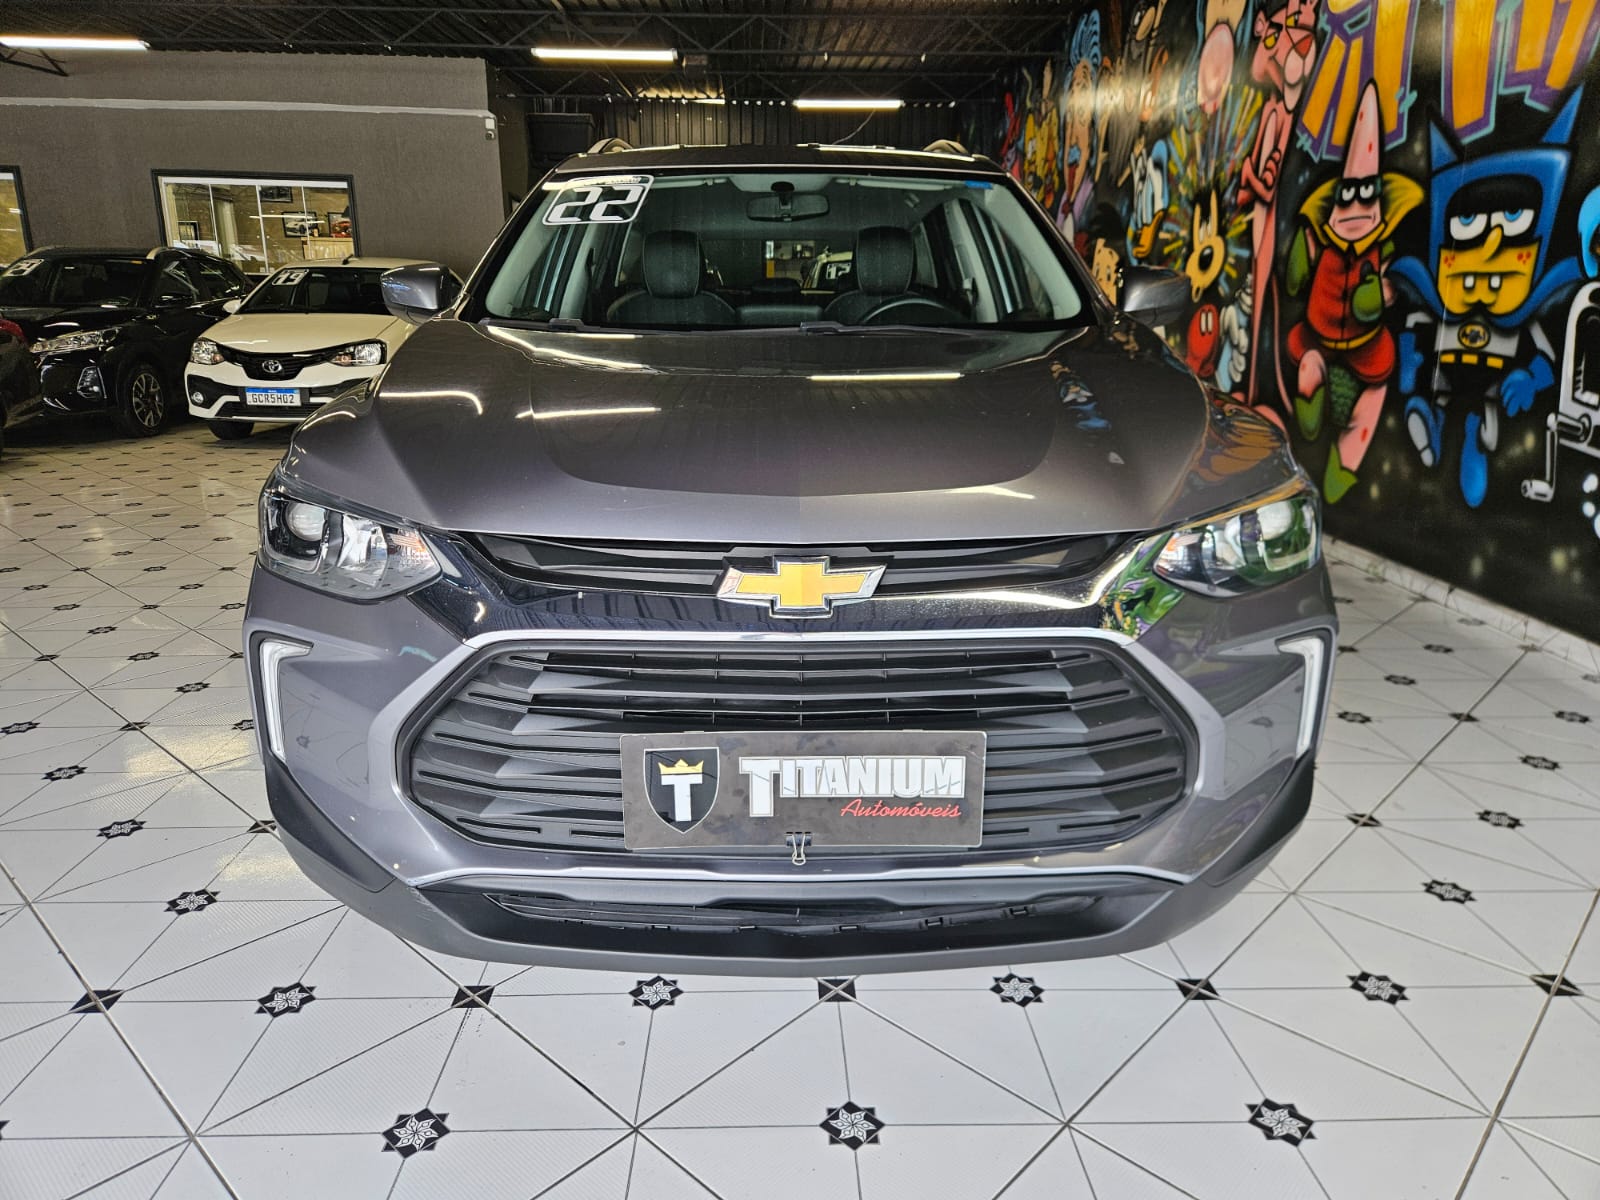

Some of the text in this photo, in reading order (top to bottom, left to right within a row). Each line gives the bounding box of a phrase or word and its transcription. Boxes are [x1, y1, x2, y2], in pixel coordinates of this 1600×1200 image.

[547, 185, 645, 223] 22
[275, 270, 306, 285] 19
[660, 773, 703, 822] T
[738, 755, 966, 817] TITANIUM
[840, 799, 962, 818] Automóveis
